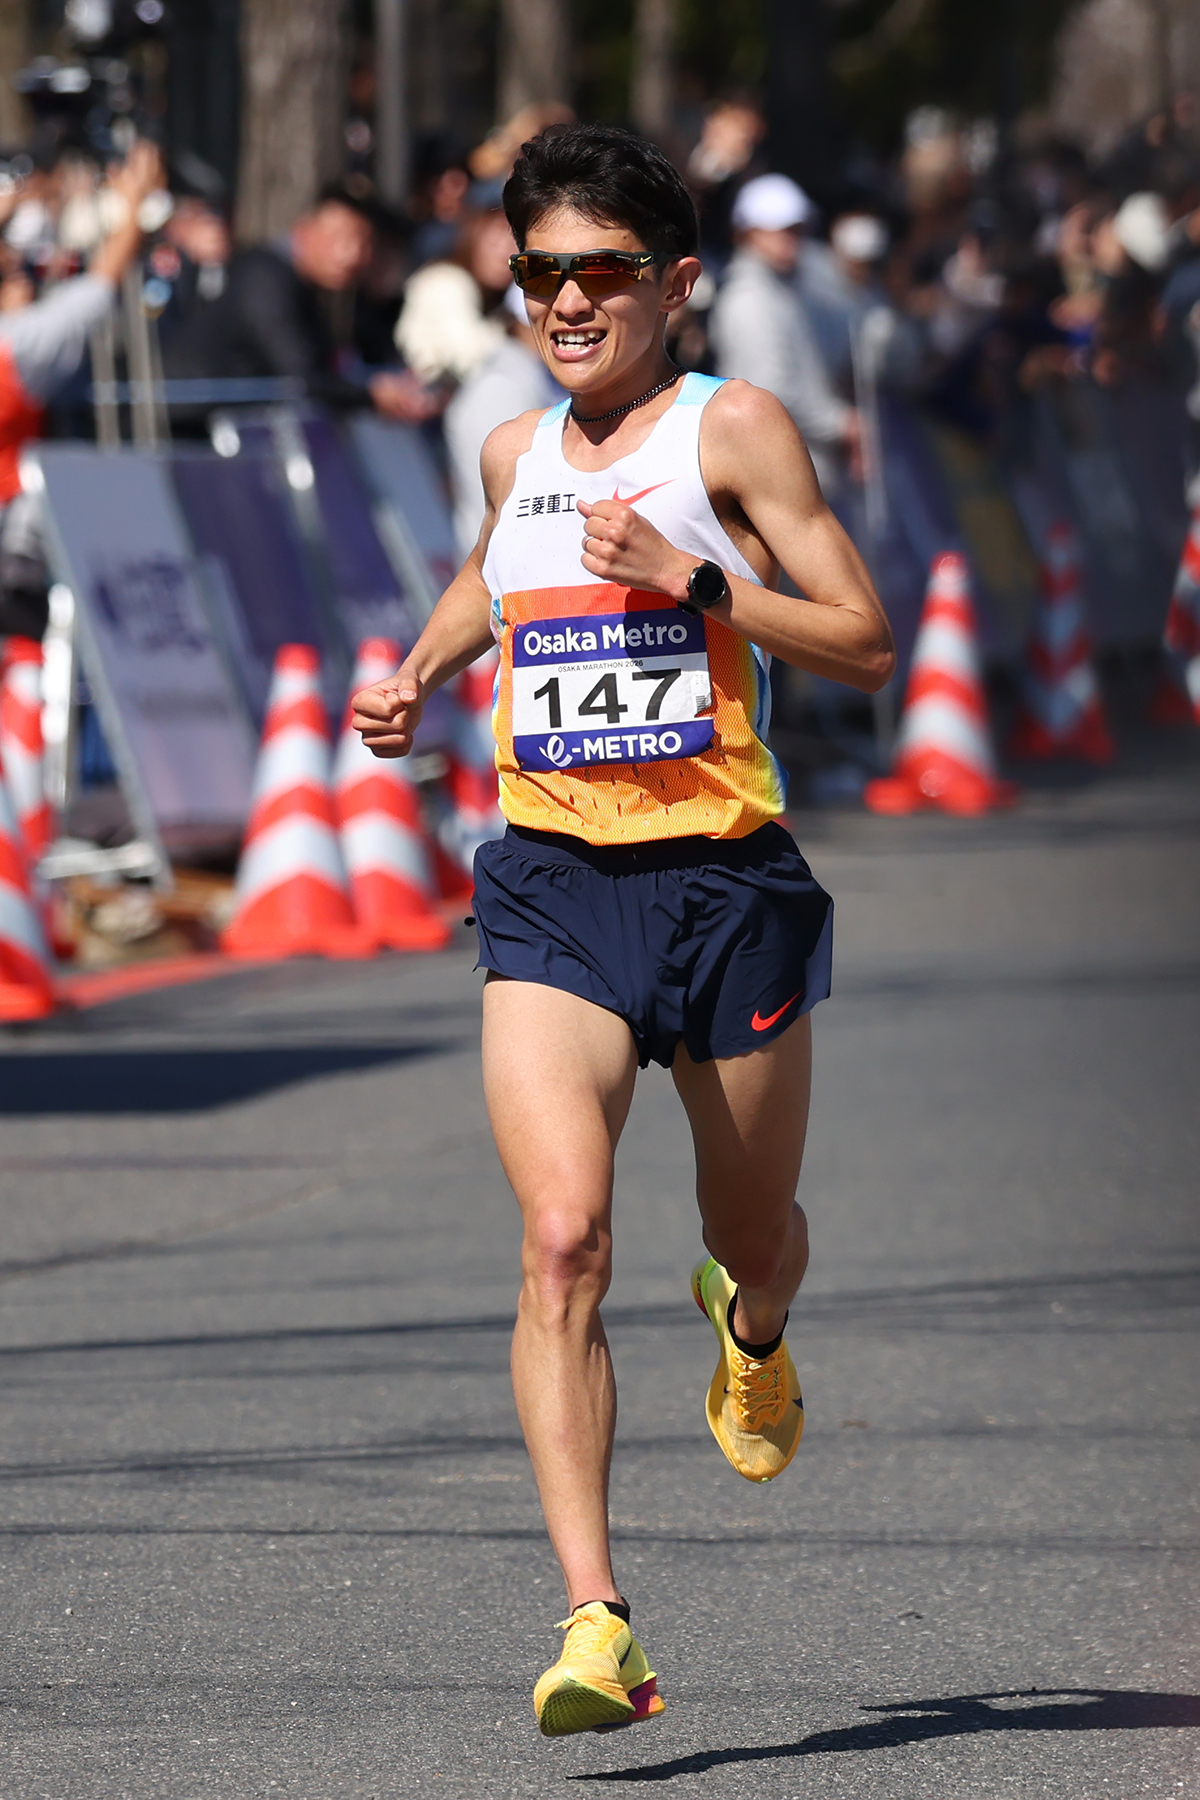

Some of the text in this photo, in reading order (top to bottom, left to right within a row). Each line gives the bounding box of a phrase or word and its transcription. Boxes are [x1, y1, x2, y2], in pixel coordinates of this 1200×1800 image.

[516, 493, 576, 518] 三菱重工
[523, 623, 688, 656] Osaka Metro
[557, 659, 644, 673] OSAKA MARATHON 2026
[533, 668, 682, 729] 147
